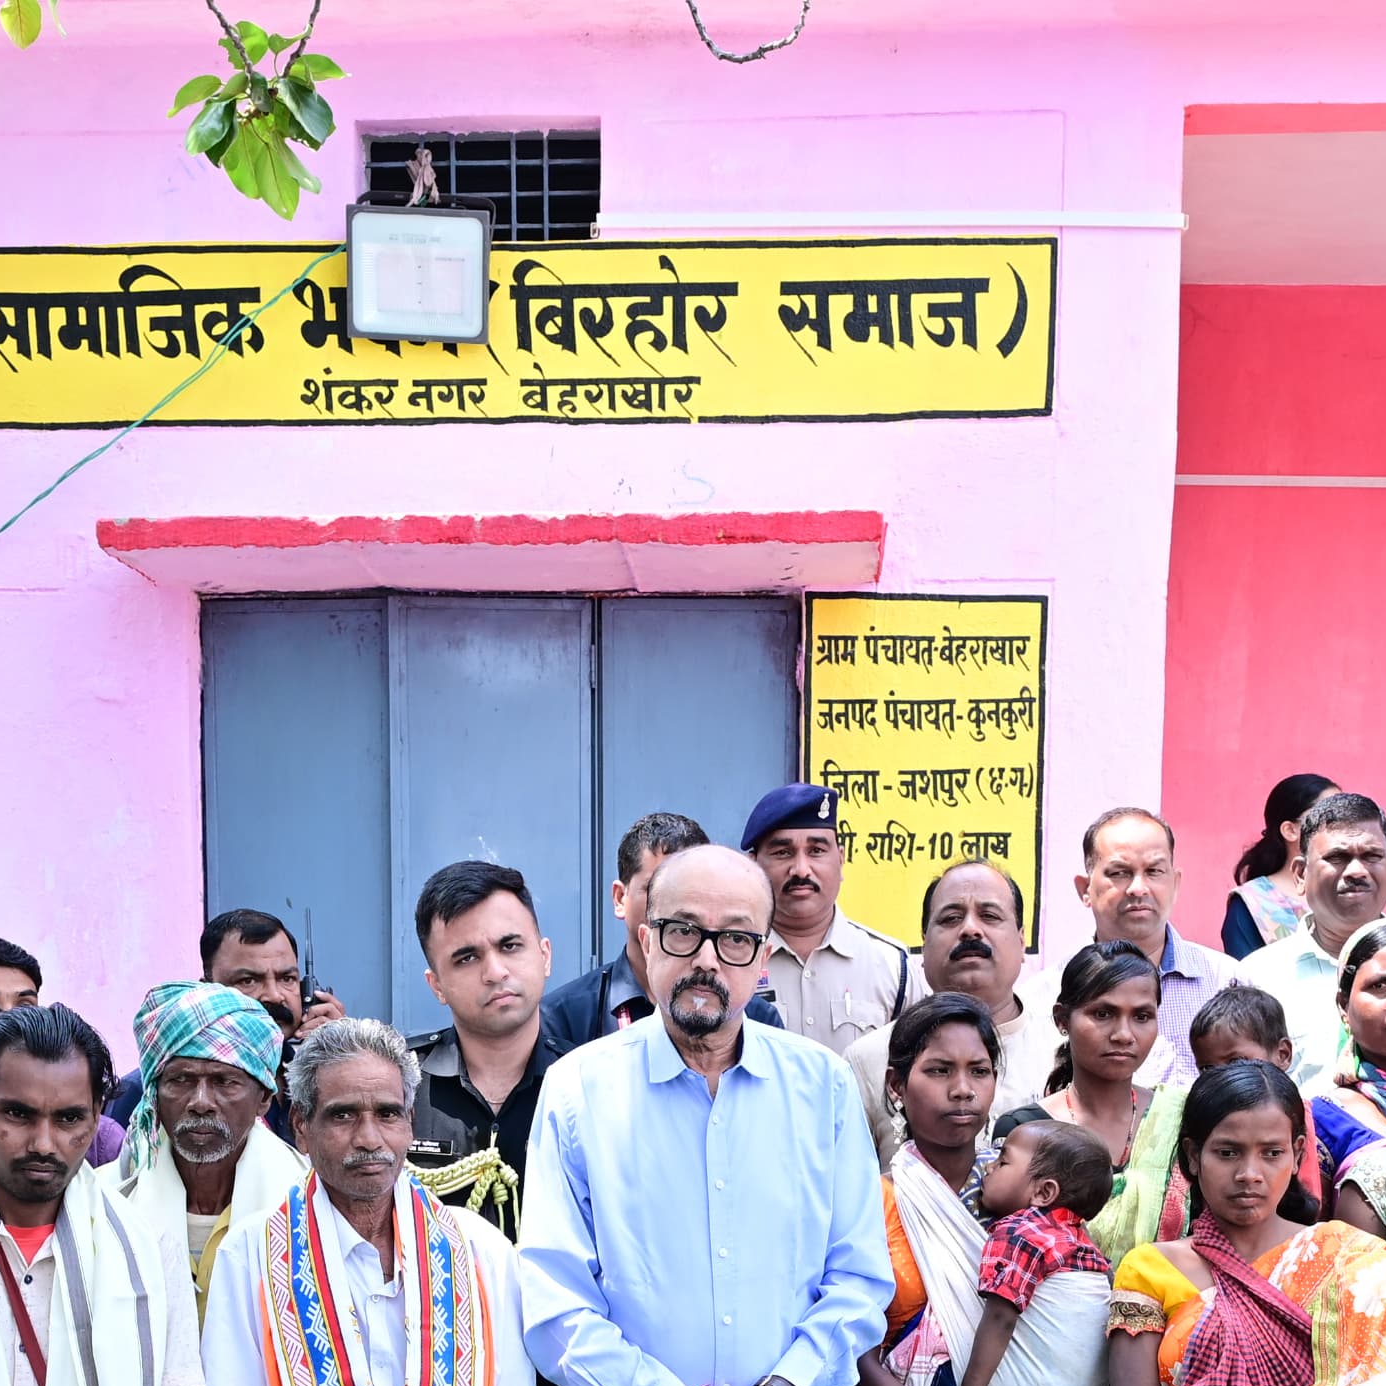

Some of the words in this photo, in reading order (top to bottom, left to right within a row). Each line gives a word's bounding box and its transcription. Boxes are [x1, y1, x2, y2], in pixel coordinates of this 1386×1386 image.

[300, 367, 399, 418] शंकर
[408, 378, 489, 418] नगर
[816, 635, 859, 666] ग्राम
[817, 699, 881, 738] जनपद
[820, 759, 880, 809] जिला
[897, 768, 972, 808] जशपुर
[960, 831, 1013, 860] लाख
